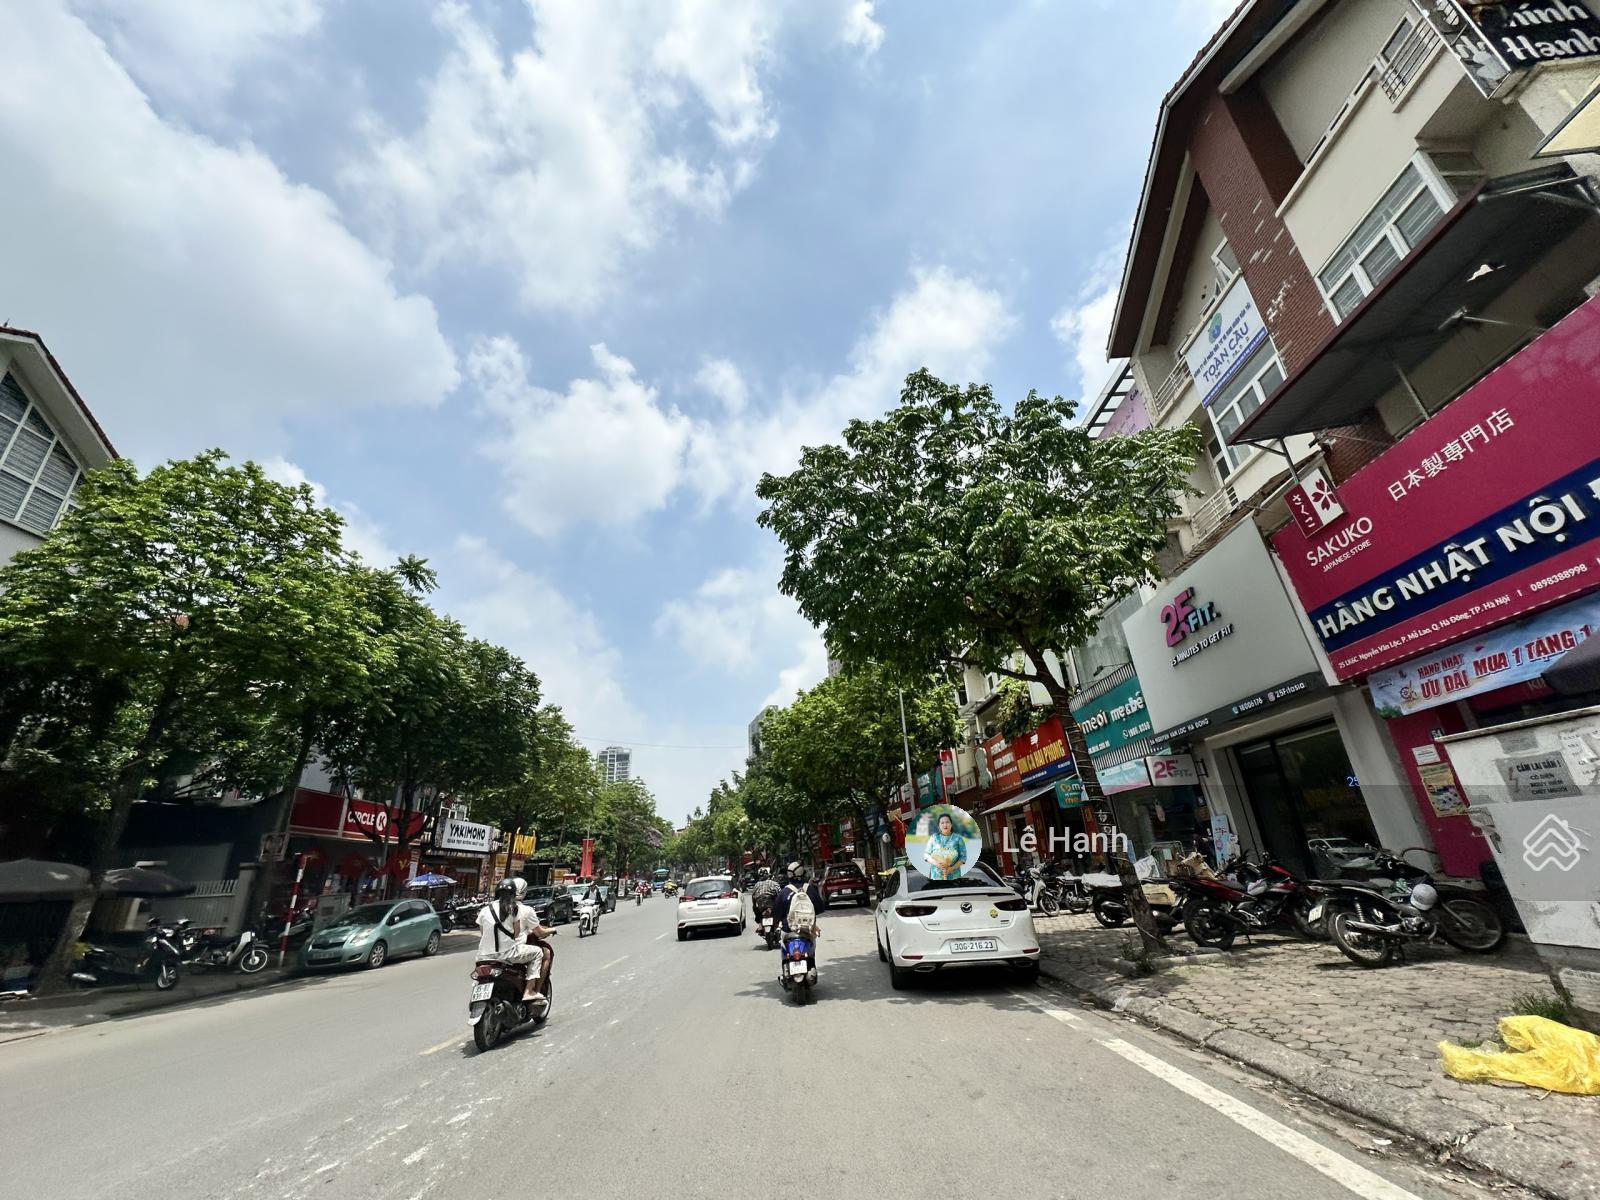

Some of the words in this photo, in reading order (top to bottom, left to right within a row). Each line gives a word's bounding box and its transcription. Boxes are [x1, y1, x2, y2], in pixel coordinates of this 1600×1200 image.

[1203, 348, 1229, 382] TOÀN
[1228, 322, 1248, 350] CẦU
[1388, 408, 1514, 501] 日本製専門店
[1306, 517, 1373, 566] SAKUKO
[1323, 553, 1351, 572] JAPANESE
[1350, 540, 1372, 556] STORE
[1317, 586, 1395, 639] HÀNG
[1397, 537, 1490, 601] NHẬT
[1496, 494, 1586, 552] NỘI
[1530, 563, 1588, 592] 0898388998
[1177, 643, 1200, 662] MINUTES
[1200, 638, 1209, 650] TO
[1208, 631, 1221, 645] GET
[1220, 623, 1233, 639] FIT
[1472, 652, 1509, 677] MUA
[1512, 647, 1522, 665] 1
[1525, 629, 1578, 663] TẶNG
[450, 823, 486, 841] YAKIMONO
